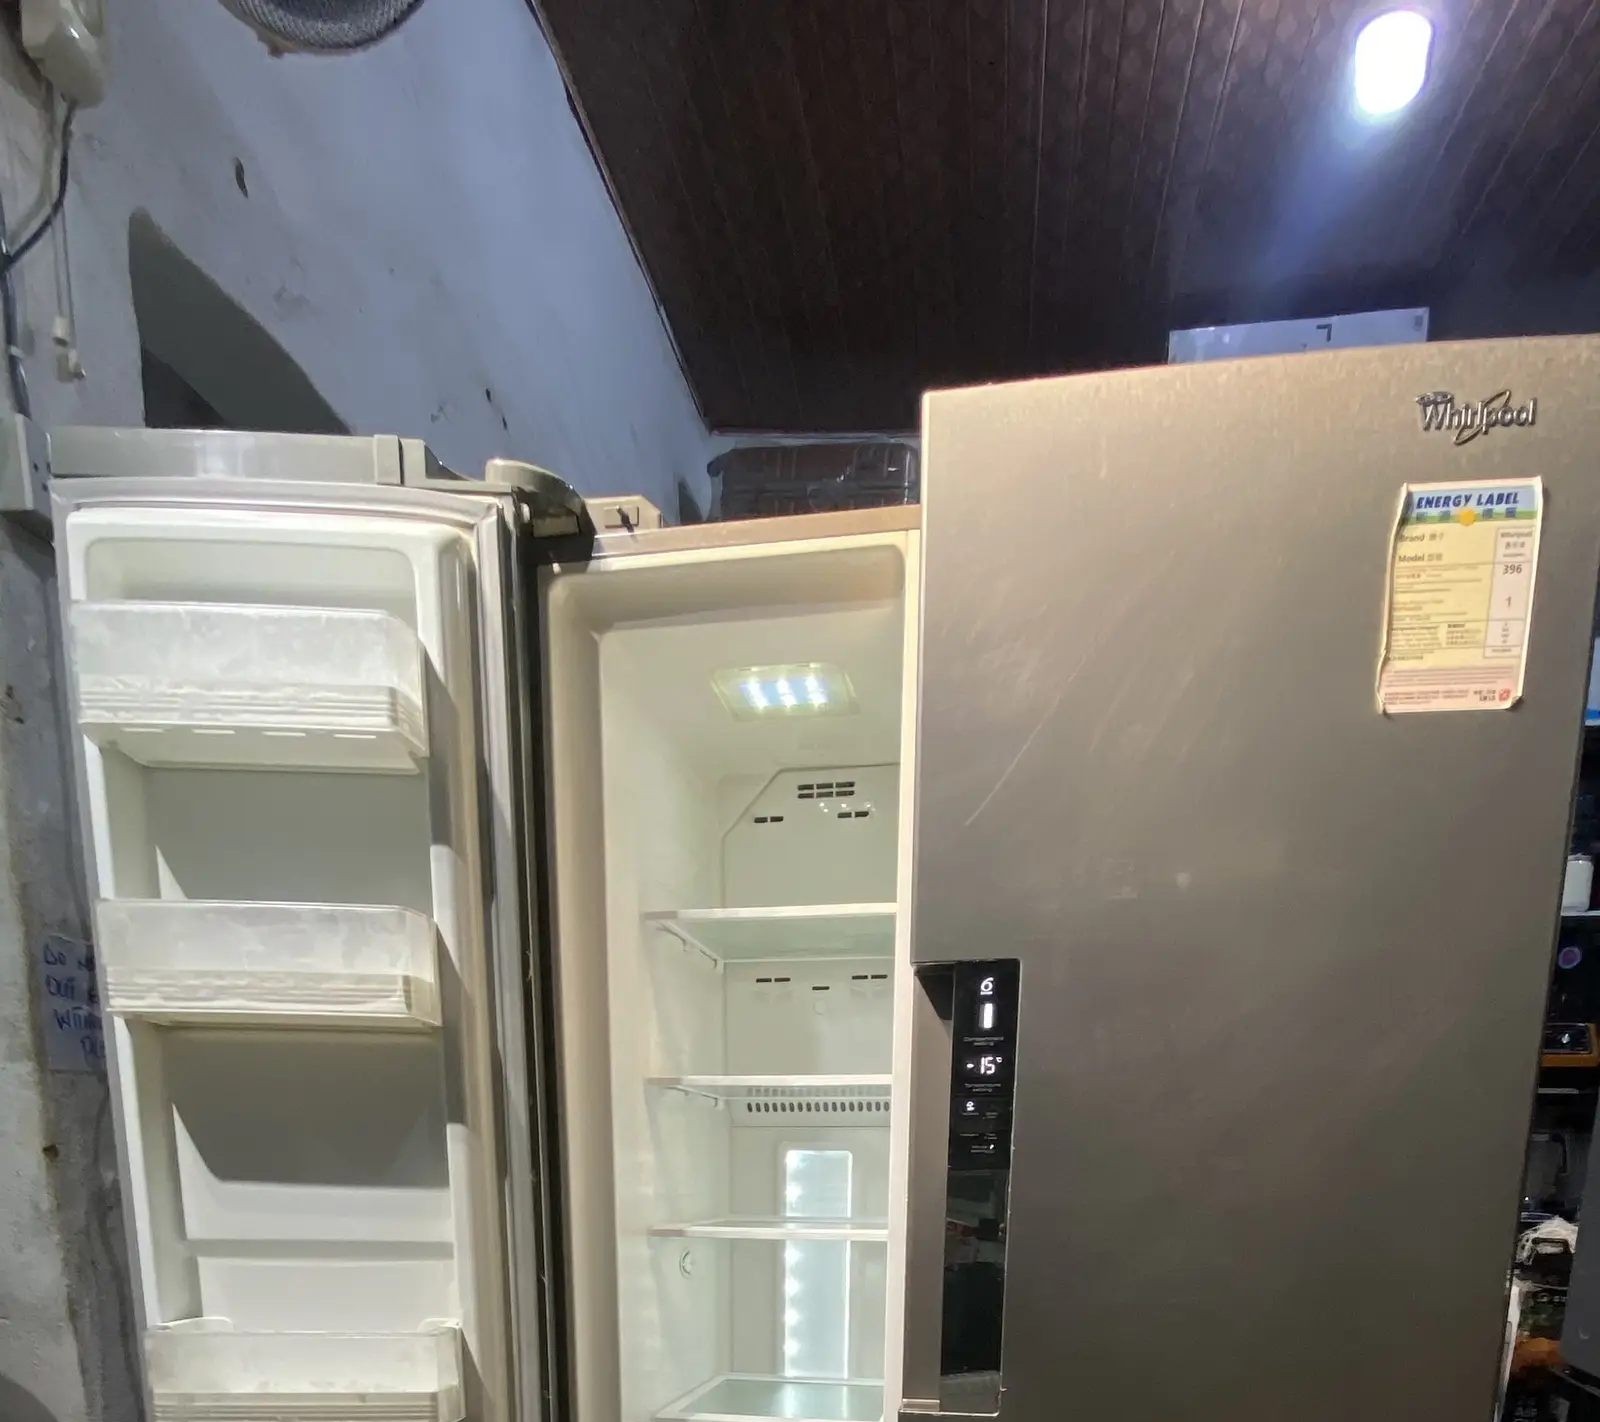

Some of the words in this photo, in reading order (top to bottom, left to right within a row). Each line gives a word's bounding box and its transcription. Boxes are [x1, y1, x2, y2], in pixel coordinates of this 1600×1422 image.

[1416, 389, 1538, 446] Whirlpool
[1416, 493, 1472, 509] ENERGY
[1476, 491, 1520, 506] LABEL
[1398, 553, 1425, 562] Model
[1502, 564, 1523, 575] 396
